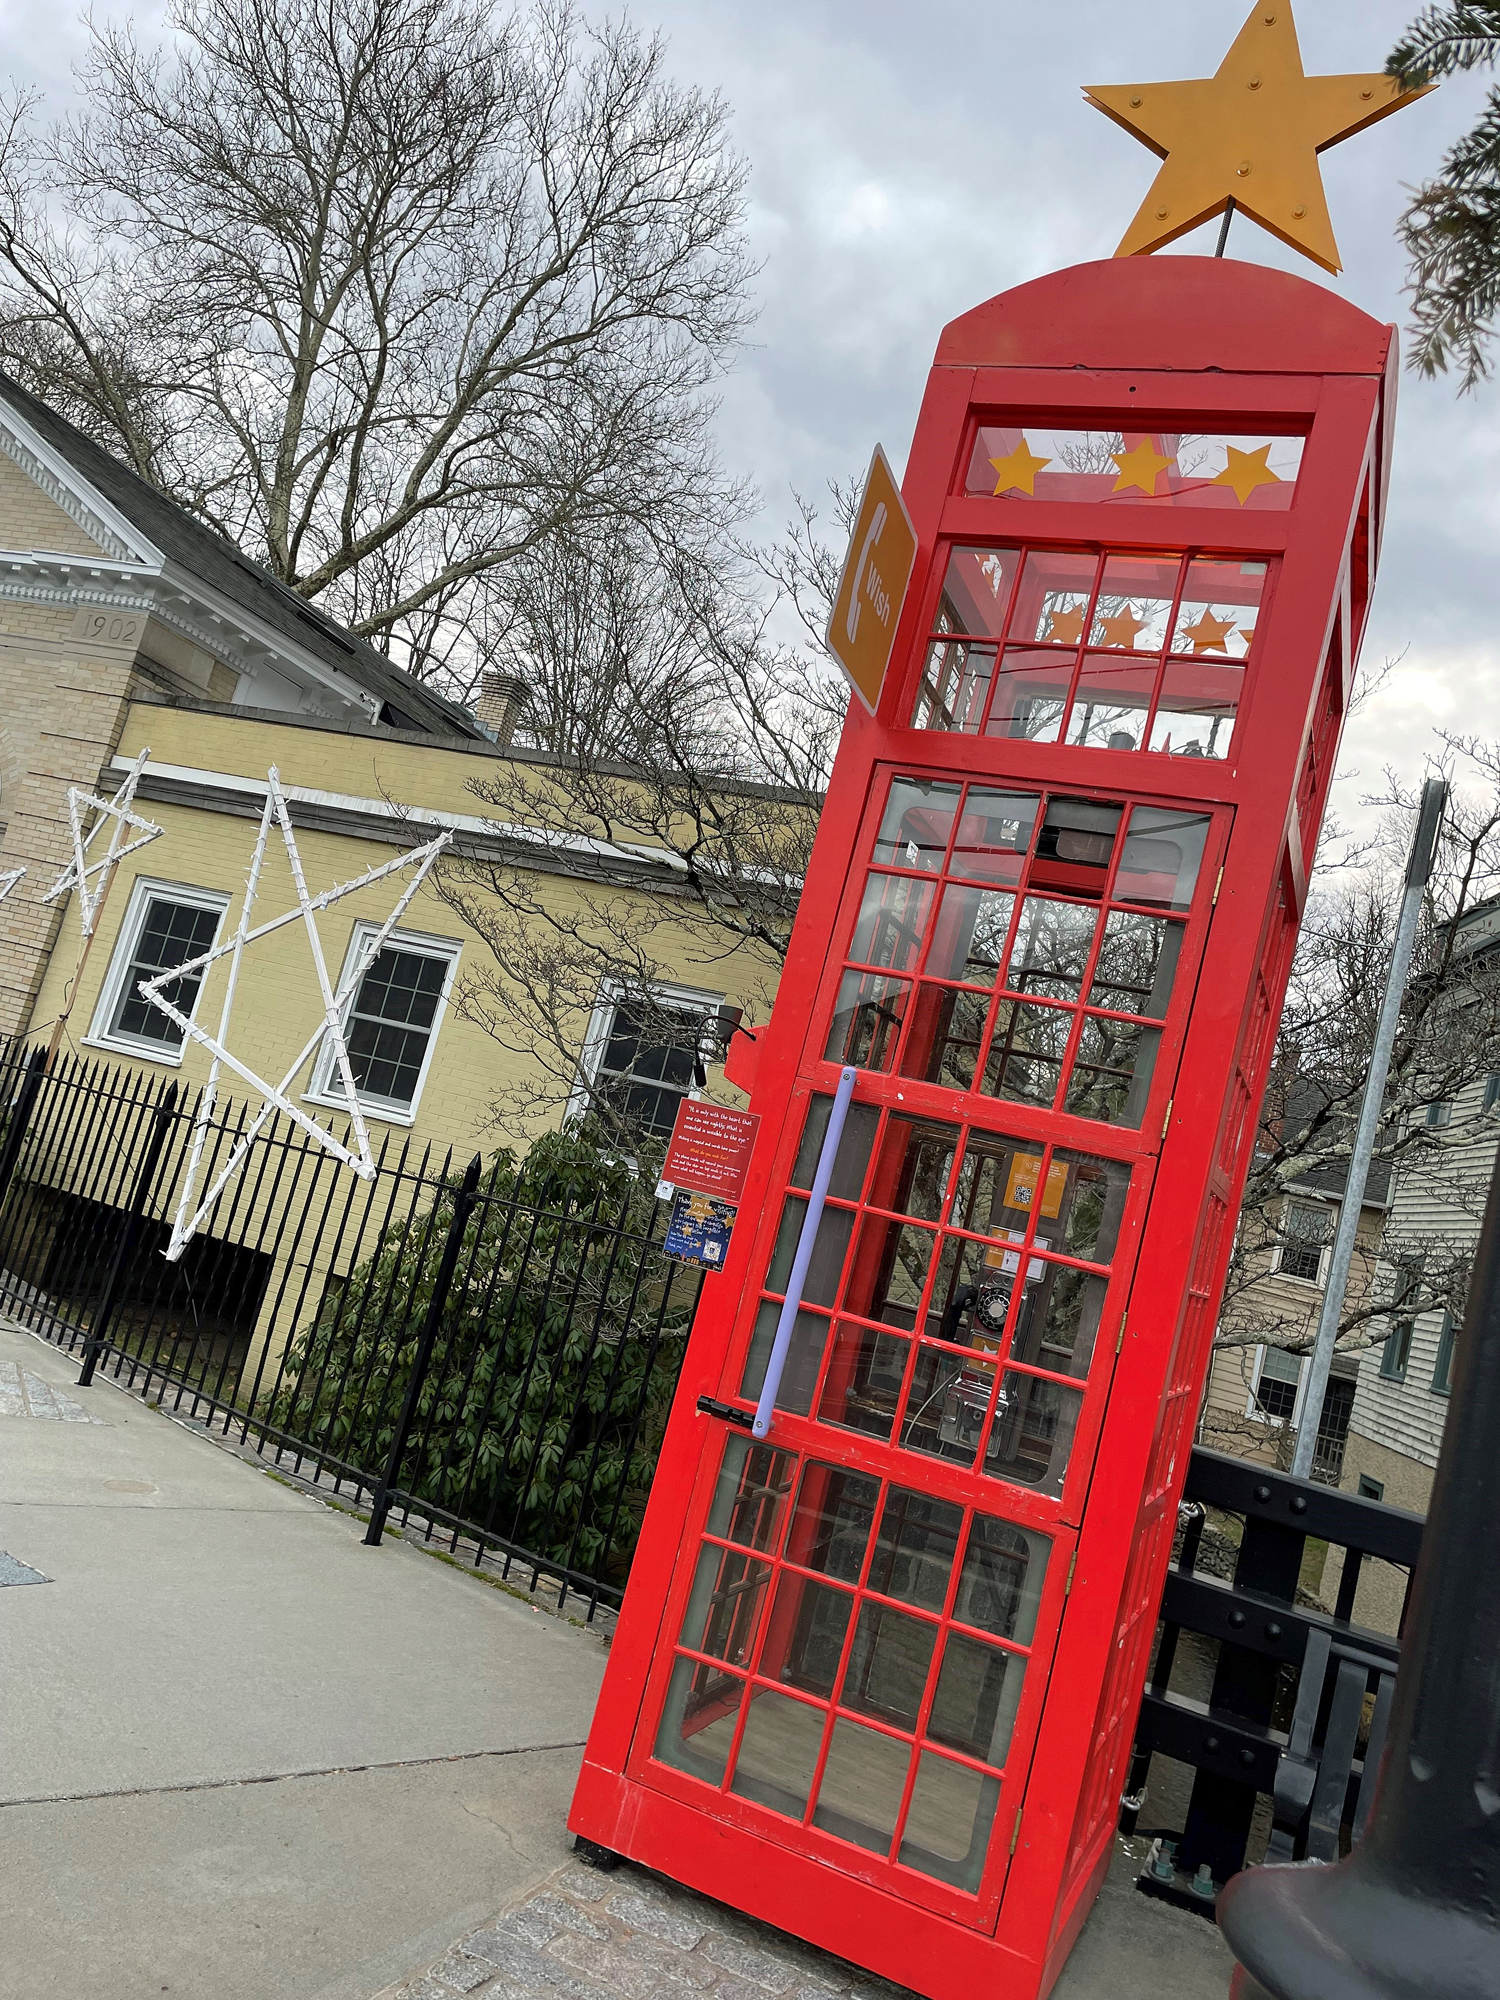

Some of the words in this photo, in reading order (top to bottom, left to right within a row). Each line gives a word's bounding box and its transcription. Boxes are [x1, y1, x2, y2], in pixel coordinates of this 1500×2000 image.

[866, 561, 891, 628] Wish
[82, 615, 137, 642] 1902
[699, 1108, 709, 1117] only
[728, 1115, 741, 1123] heart
[741, 1118, 752, 1126] that
[683, 1123, 701, 1132] essential
[706, 1128, 722, 1137] invisible
[677, 1195, 692, 1205] Thank
[692, 1201, 703, 1210] you
[703, 1202, 712, 1211] for
